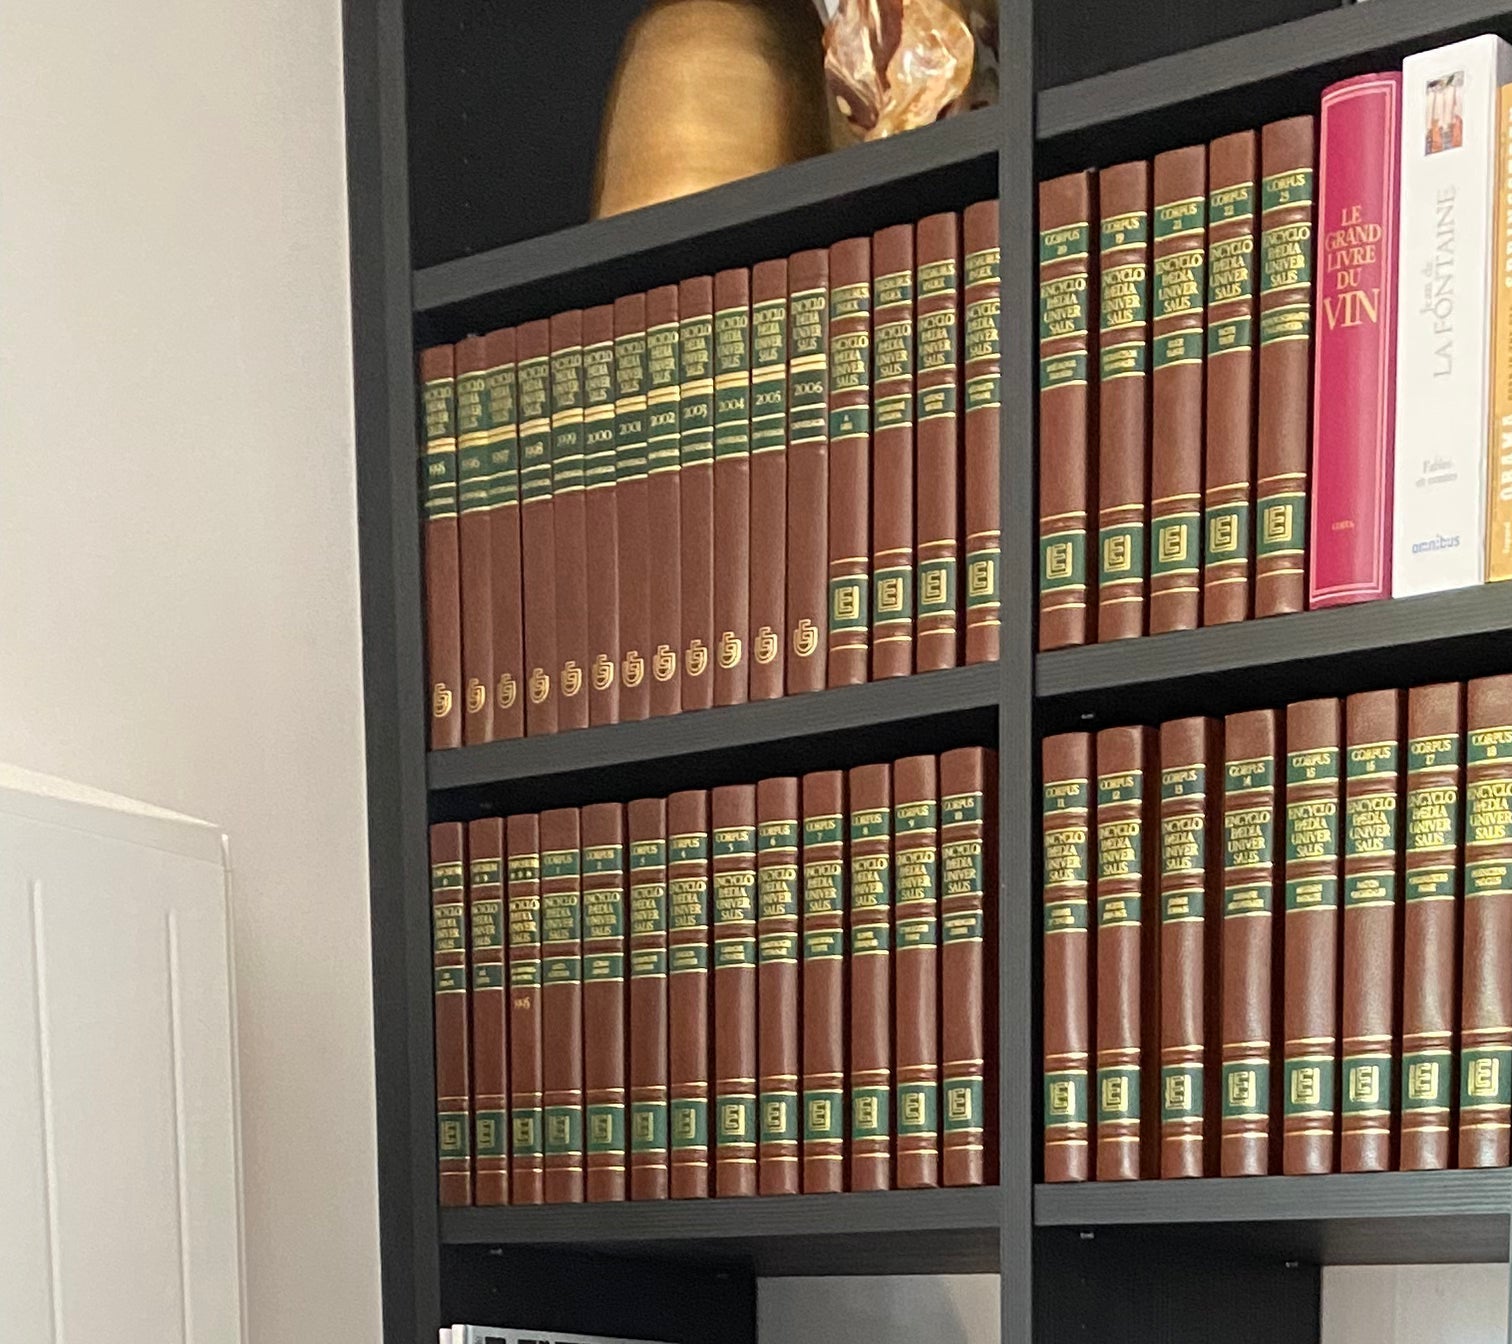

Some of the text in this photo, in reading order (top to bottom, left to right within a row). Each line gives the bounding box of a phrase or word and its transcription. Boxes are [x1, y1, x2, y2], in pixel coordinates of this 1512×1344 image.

[1341, 205, 1362, 226] LE
[1325, 224, 1382, 250] GRAND
[1327, 245, 1376, 273] LIVRE
[1336, 269, 1362, 289] DU
[1434, 184, 1456, 378] LA FONTAINE
[1323, 288, 1380, 330] VIN
[755, 391, 781, 405] 2005
[794, 382, 824, 396] 2006
[718, 398, 745, 412] 2004
[651, 412, 676, 426] 2002
[1412, 534, 1460, 554] omnibus
